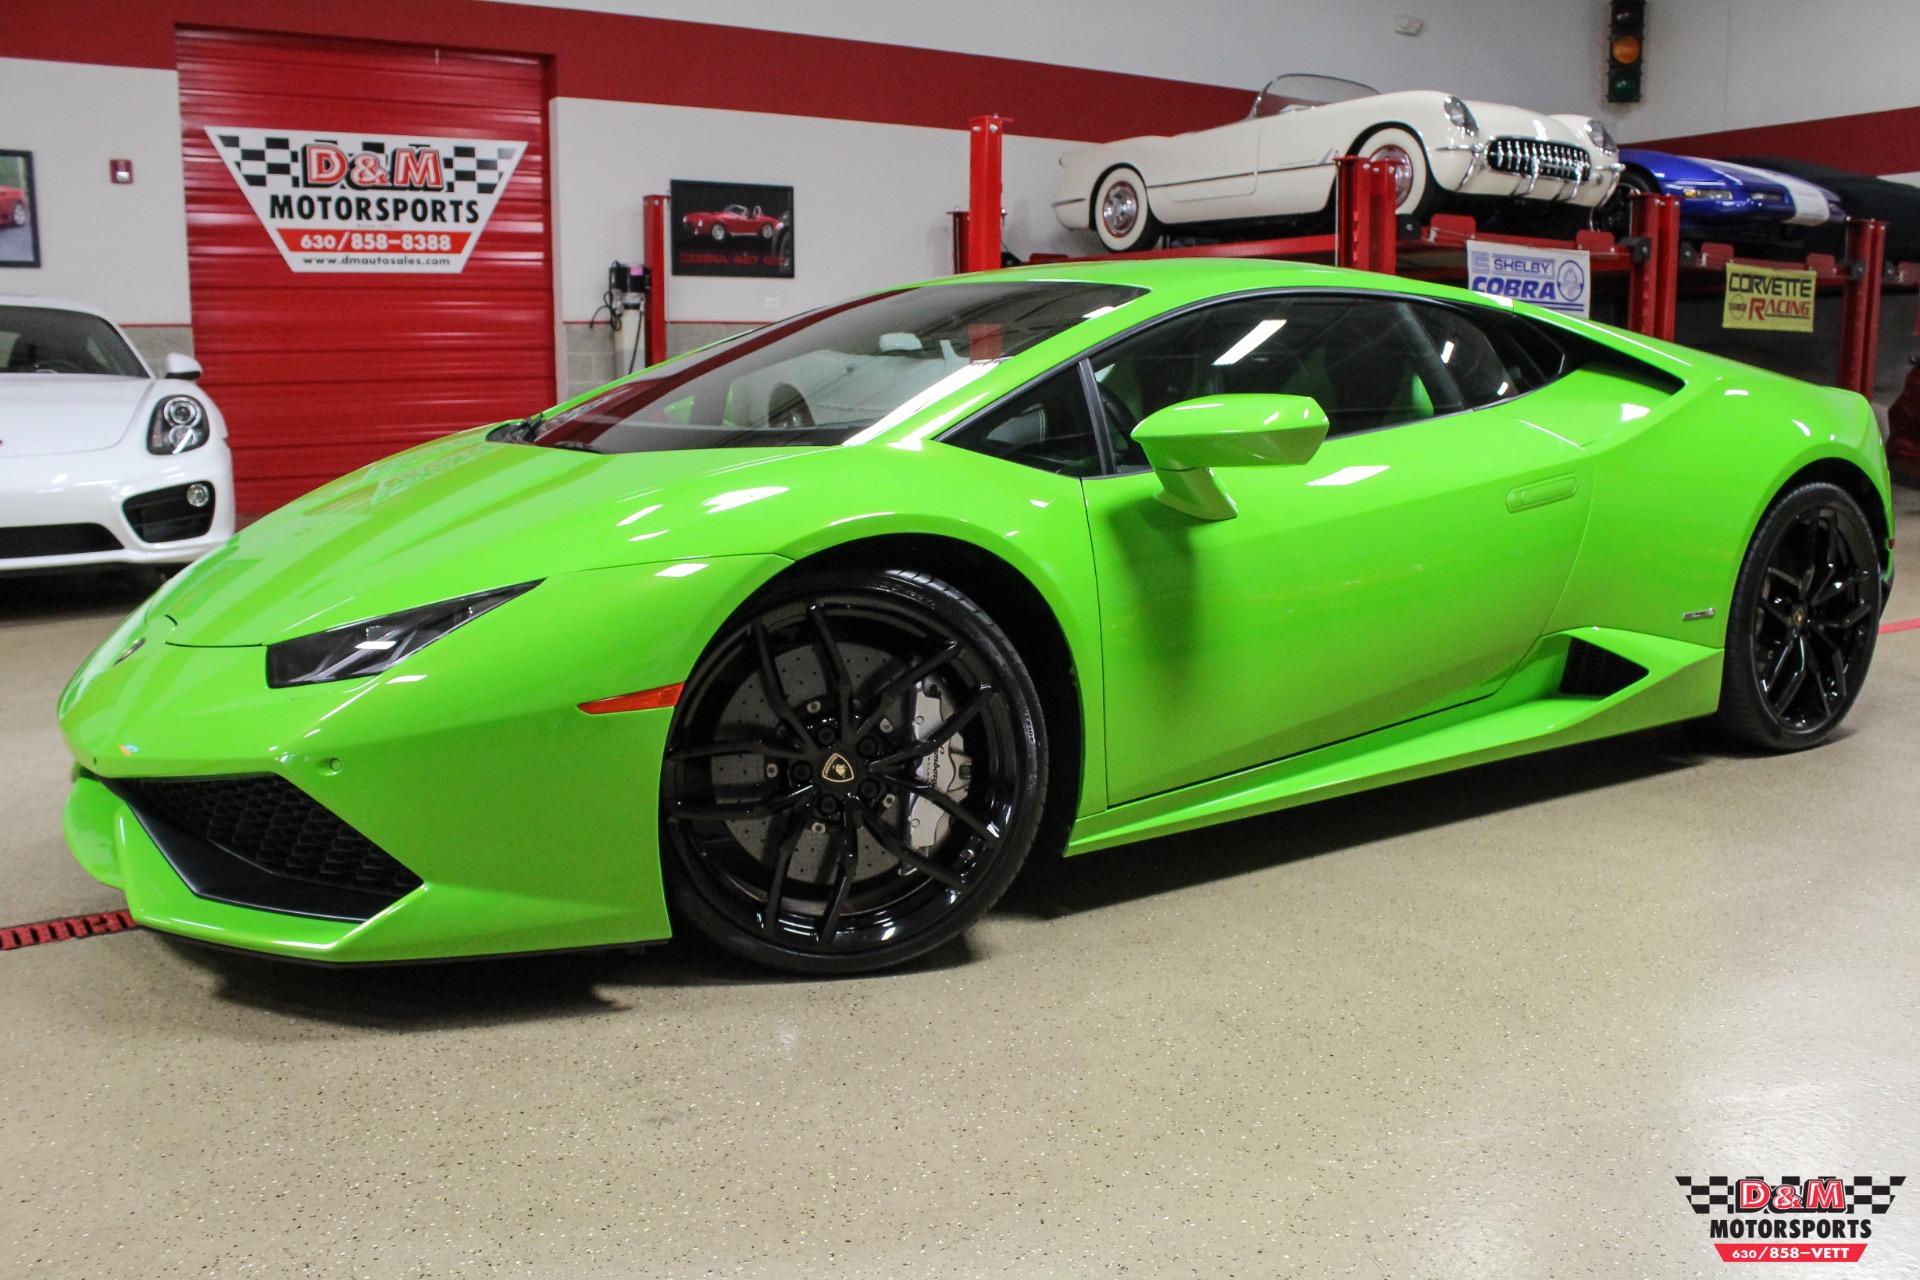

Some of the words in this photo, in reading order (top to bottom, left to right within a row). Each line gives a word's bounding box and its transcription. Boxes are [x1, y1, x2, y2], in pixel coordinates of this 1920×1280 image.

[303, 144, 444, 190] D&M
[270, 195, 479, 223] MOTORSPORTS
[300, 231, 451, 251] 630/858-8388
[302, 257, 450, 266] www.dmautosales.com
[1494, 259, 1550, 273] SHELBY
[1472, 276, 1556, 299] COBRA
[1729, 273, 1811, 297] CORVETTE
[1748, 298, 1811, 320] RACING
